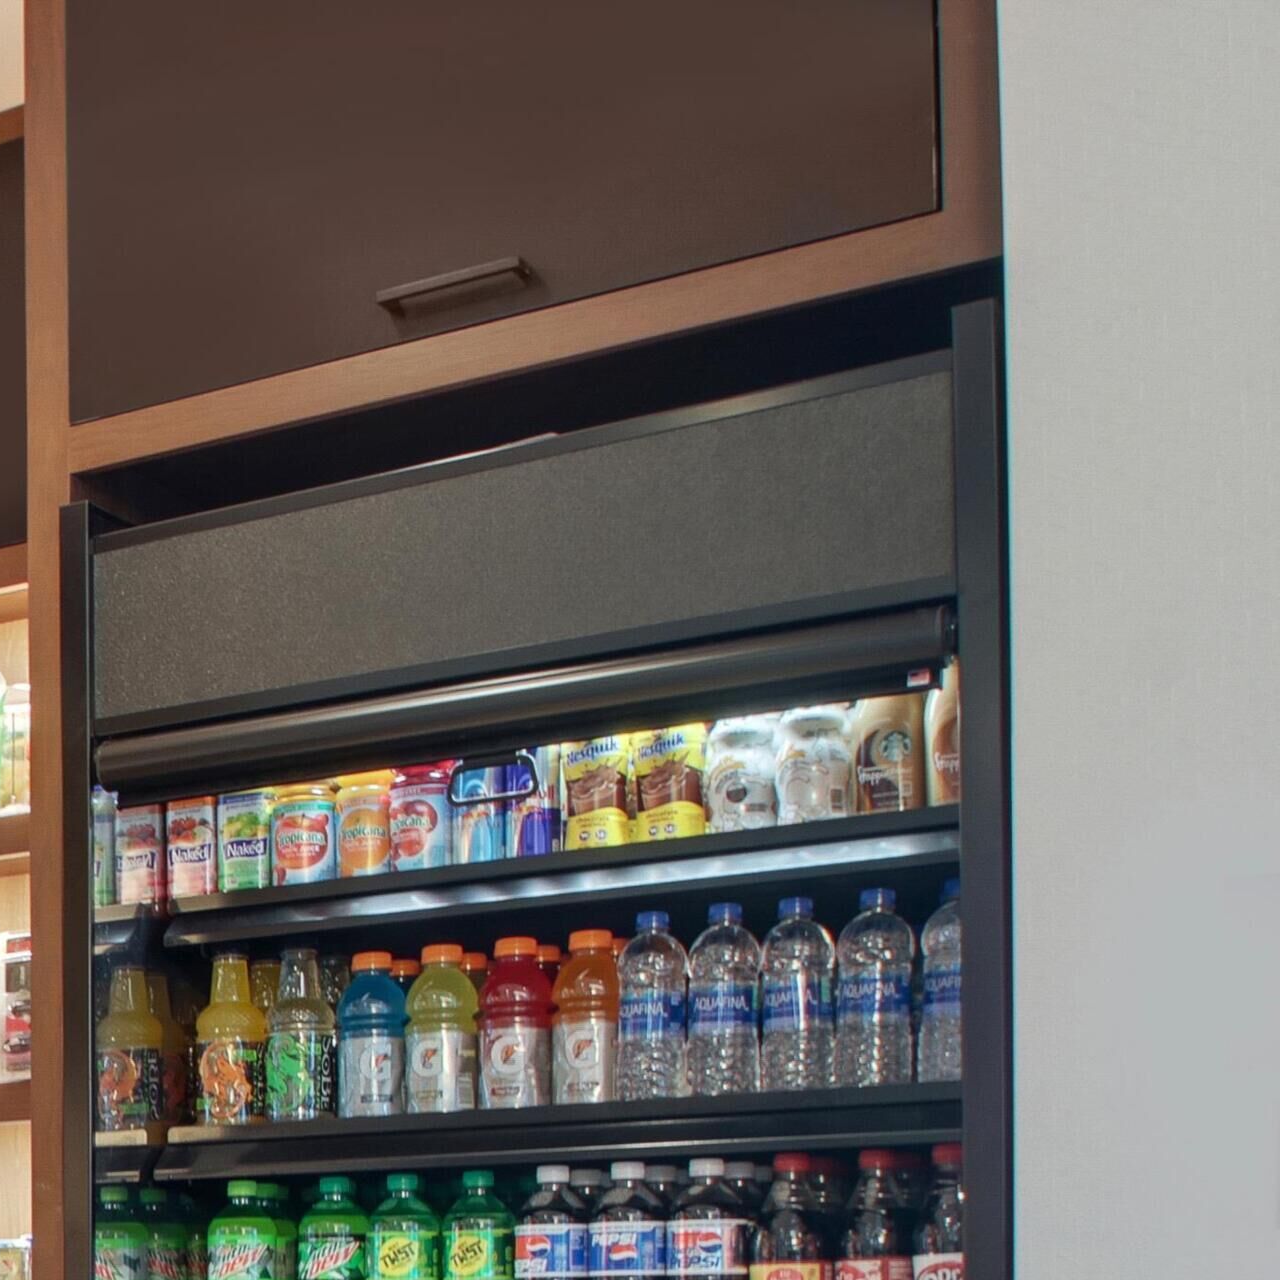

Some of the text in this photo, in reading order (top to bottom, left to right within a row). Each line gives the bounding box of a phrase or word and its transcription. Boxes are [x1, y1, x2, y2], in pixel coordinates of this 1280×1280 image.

[566, 736, 618, 765] Nesquik
[171, 847, 210, 863] Naked
[226, 840, 267, 857] Naked
[592, 1232, 637, 1247] PEPSI
